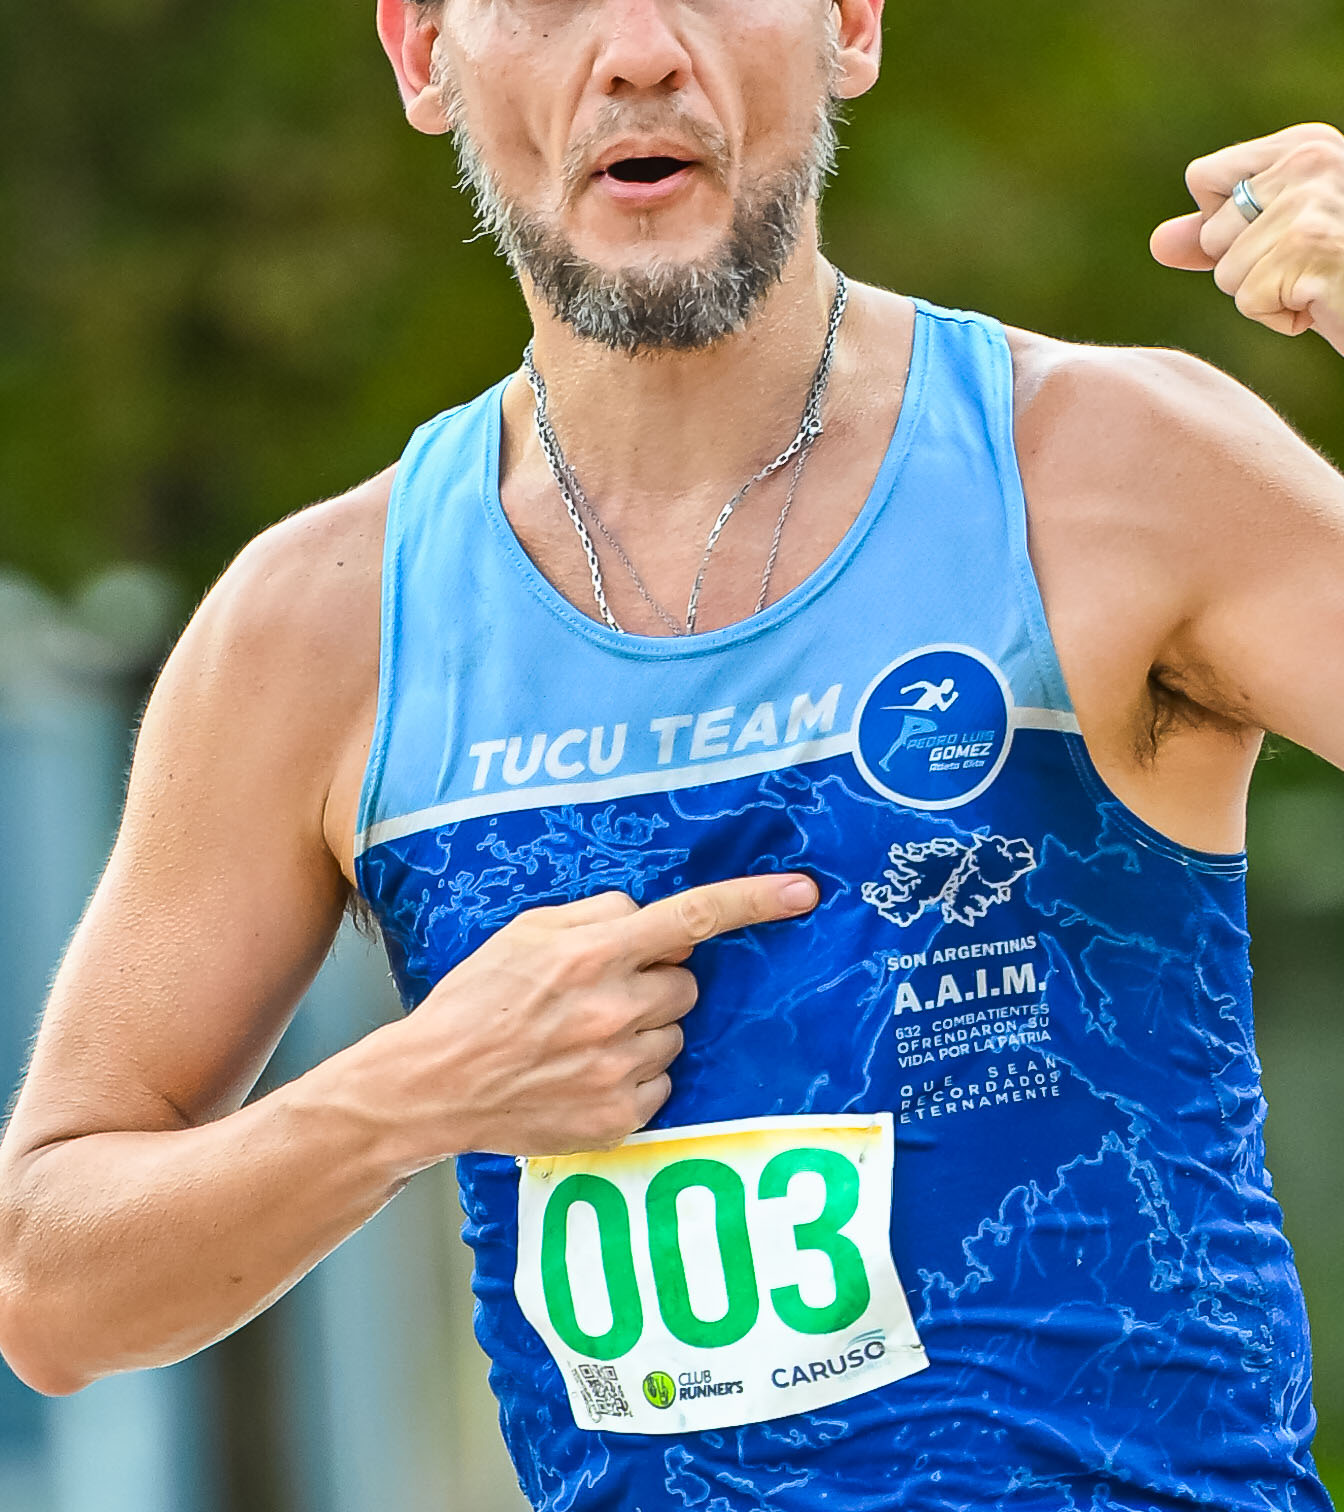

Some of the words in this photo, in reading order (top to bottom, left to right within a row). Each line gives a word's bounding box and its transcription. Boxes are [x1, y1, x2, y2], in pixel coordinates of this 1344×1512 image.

[469, 723, 627, 791] TUCU
[650, 683, 842, 764] TEAM
[906, 734, 957, 750] PEDRO
[962, 730, 995, 743] LUIS
[929, 743, 993, 761] GOMEZ
[887, 953, 926, 971] SON
[933, 936, 1036, 964] ARGENTINAS
[894, 963, 1046, 1015] A.A.I.M.
[896, 1025, 921, 1039] 632
[932, 1003, 1049, 1032] COMBATIENTES
[897, 1020, 1017, 1054] OFRENDARON
[1028, 1017, 1049, 1028] SU
[898, 1052, 935, 1068] VIDA
[939, 1044, 970, 1060] POR
[974, 1038, 994, 1052] LA
[994, 1030, 1051, 1048] PATRIA
[900, 1076, 952, 1097] QUE
[988, 1055, 1056, 1078] SEAN
[901, 1071, 1060, 1110] RECORDADOS
[900, 1086, 1060, 1124] ETERNAMENTE
[541, 1147, 871, 1361] 003
[678, 1370, 712, 1386] CLUB
[771, 1340, 886, 1389] CARUSO
[679, 1380, 744, 1401] RUNNER'S
